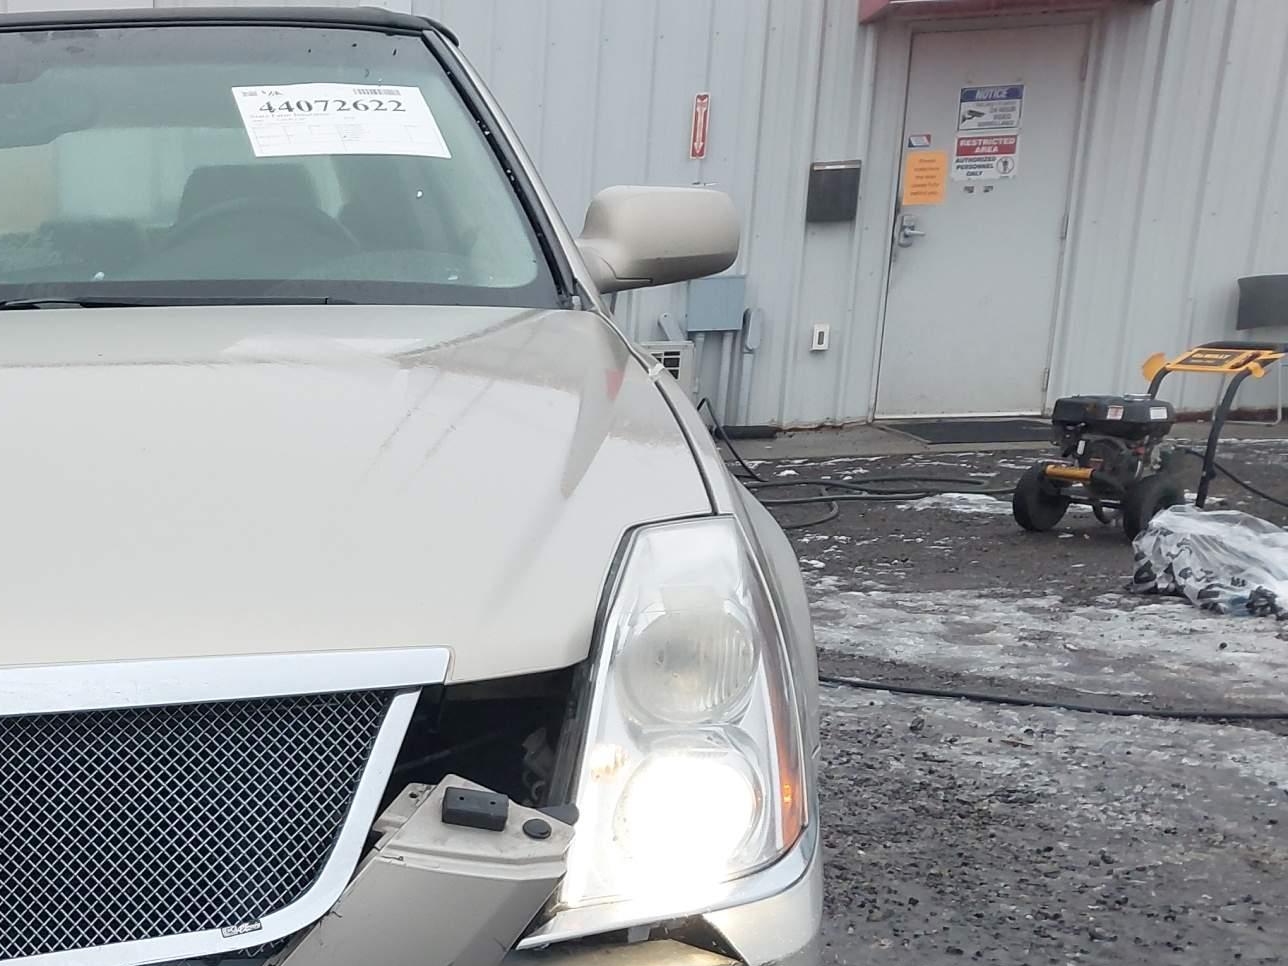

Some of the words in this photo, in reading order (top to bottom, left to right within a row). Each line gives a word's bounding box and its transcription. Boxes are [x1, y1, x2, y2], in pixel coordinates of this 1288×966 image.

[976, 87, 1008, 99] NOTICE
[259, 99, 406, 113] 44072622
[959, 137, 1016, 146] RESTRICTED
[974, 145, 999, 153] AREA
